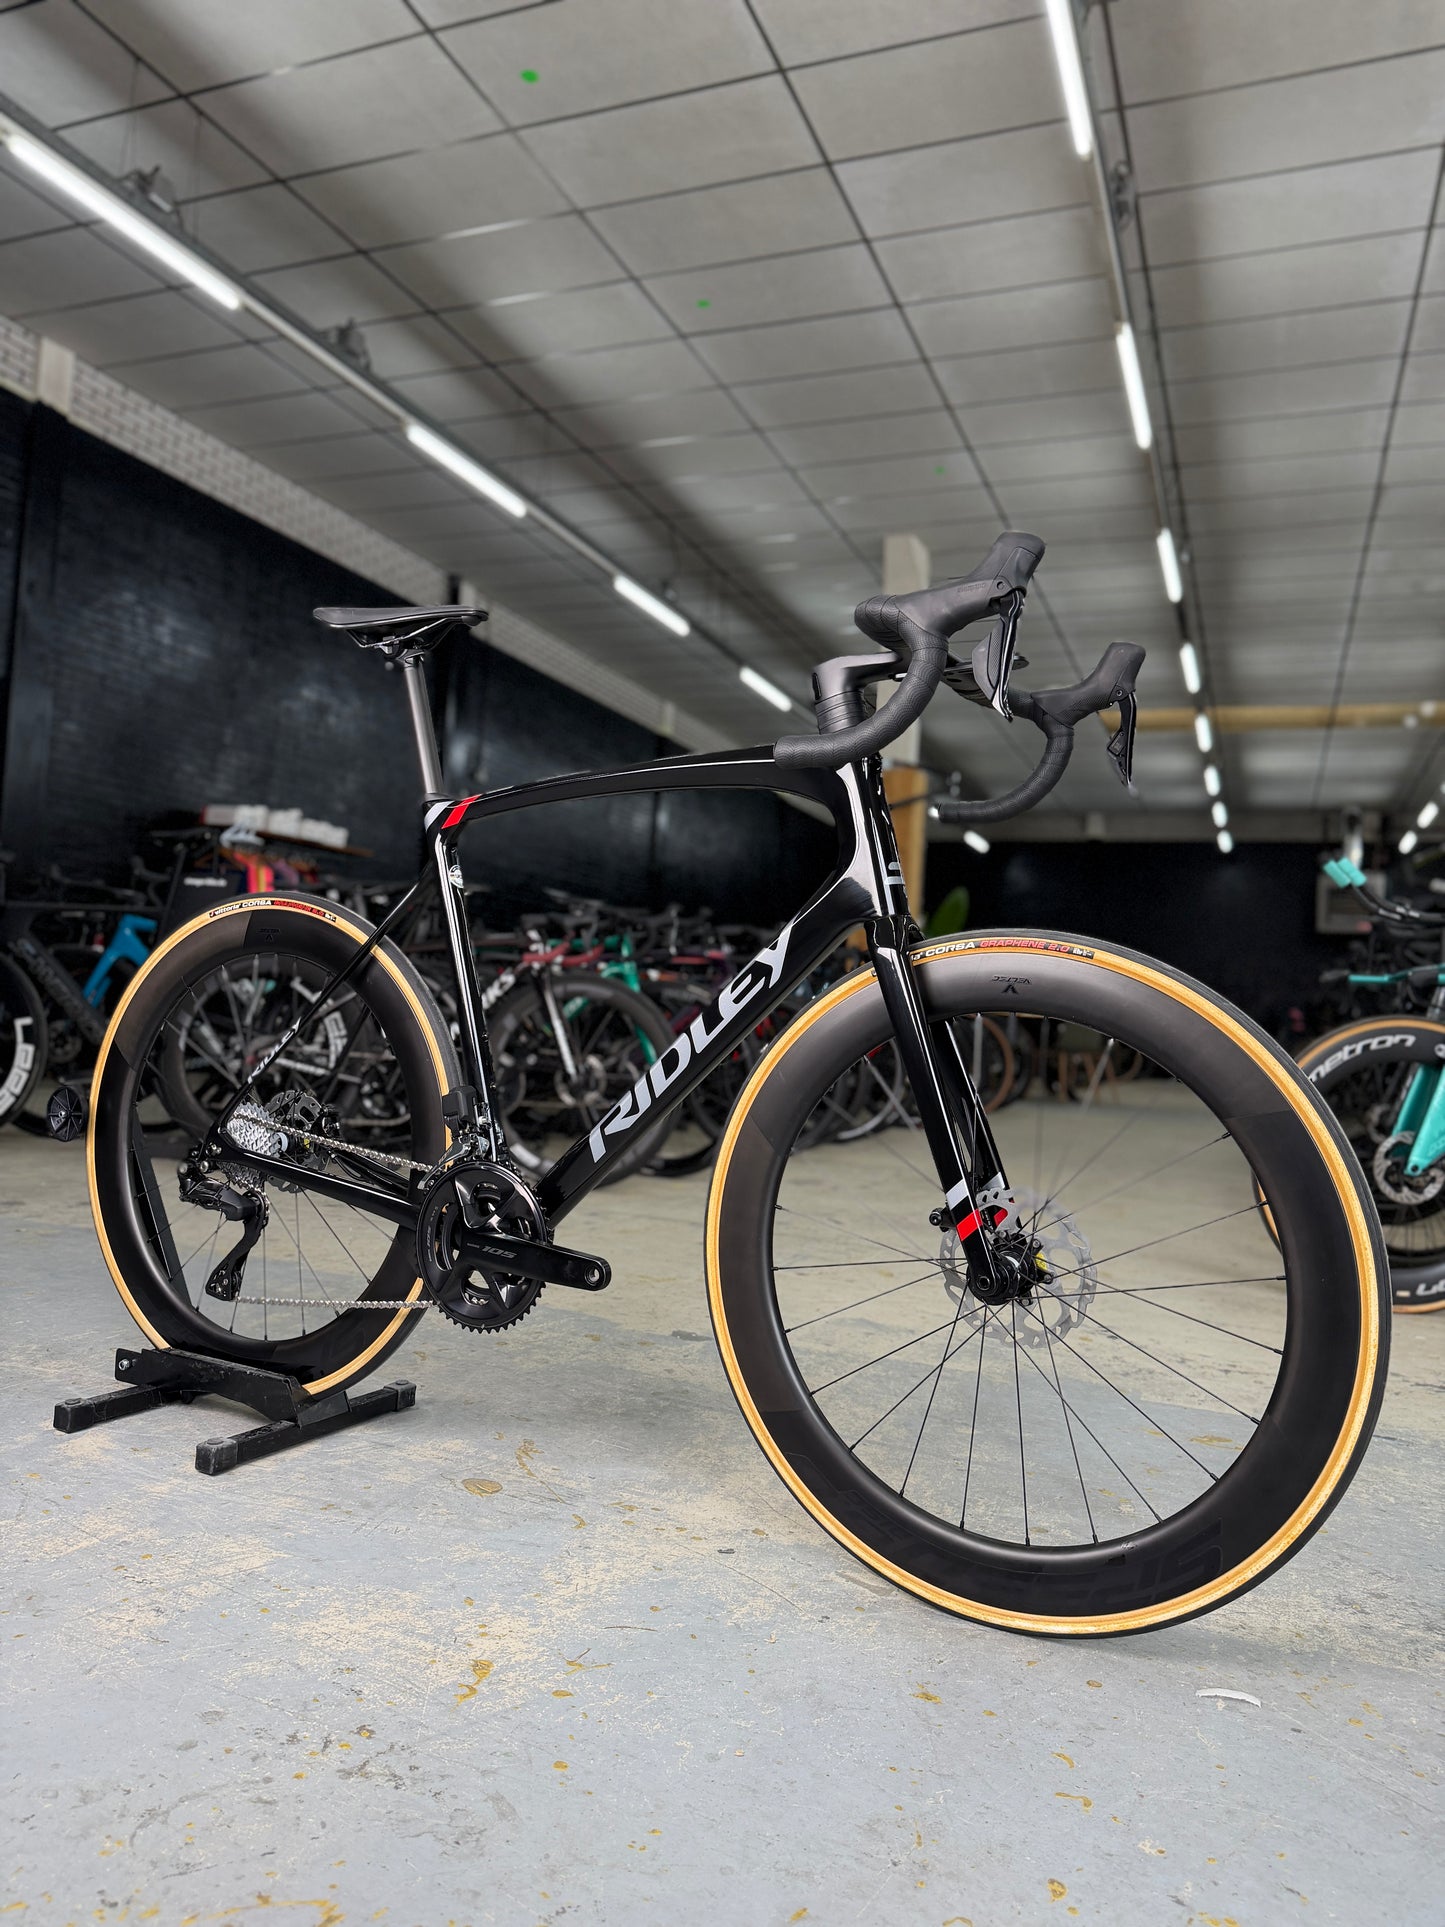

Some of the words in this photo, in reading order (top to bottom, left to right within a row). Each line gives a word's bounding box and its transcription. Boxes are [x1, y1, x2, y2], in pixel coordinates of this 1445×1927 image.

[925, 942, 975, 957] CORSA
[979, 939, 1046, 949] GRAPHENE
[1047, 943, 1070, 953] 2.0
[589, 924, 793, 1163] RIDLEY
[481, 1245, 518, 1259] 105
